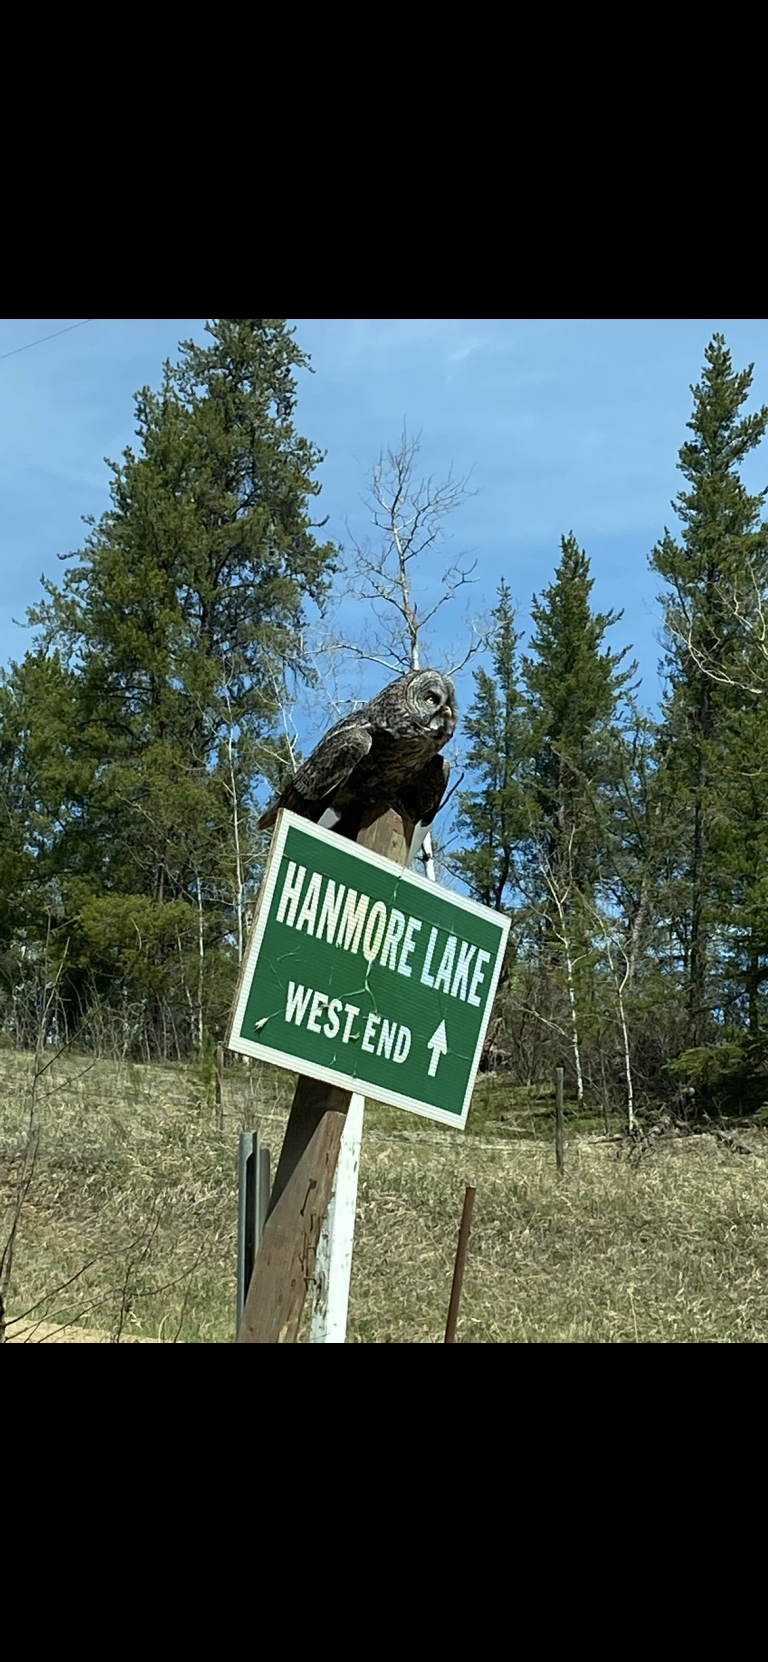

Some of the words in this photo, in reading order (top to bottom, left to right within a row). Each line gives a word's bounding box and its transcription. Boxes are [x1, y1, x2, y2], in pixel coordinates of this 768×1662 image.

[275, 861, 423, 978] HANMORE
[420, 926, 491, 1007] LAKE
[285, 981, 360, 1044] WEST
[360, 1012, 412, 1064] END
